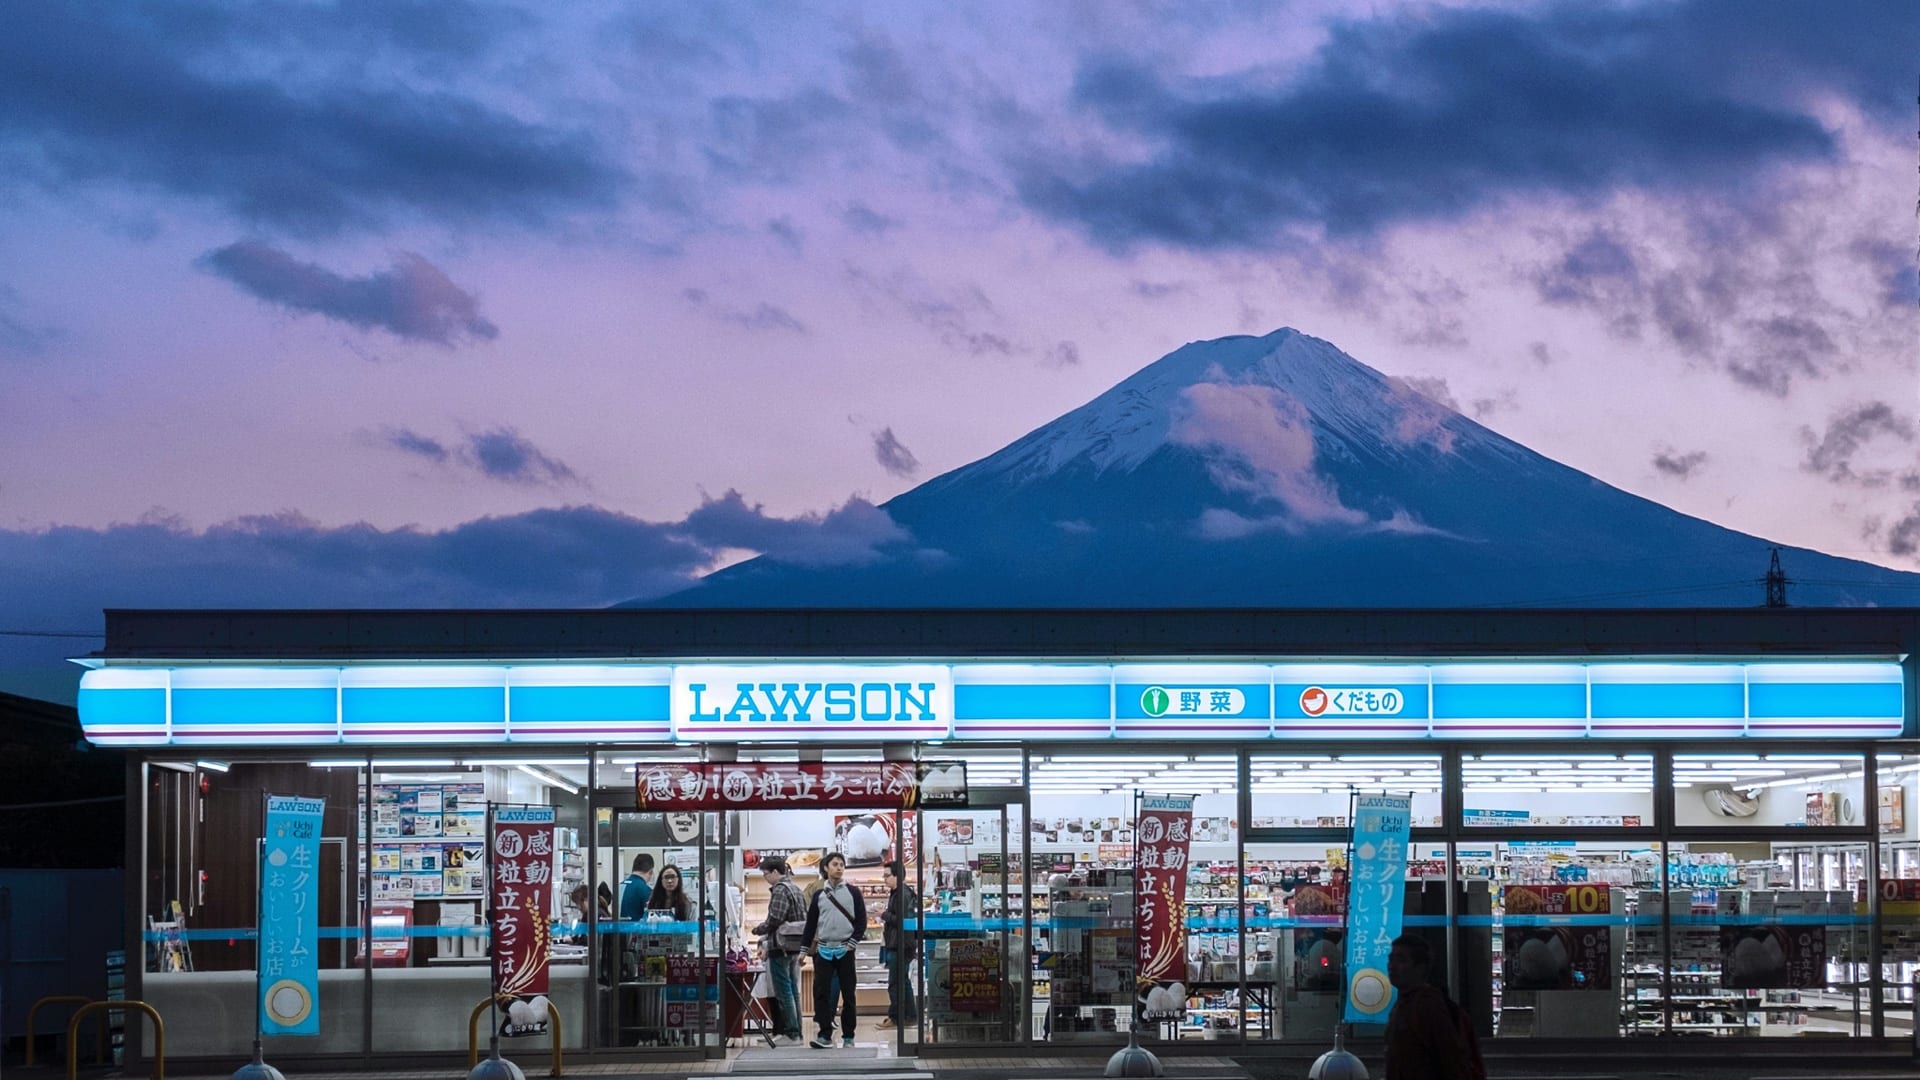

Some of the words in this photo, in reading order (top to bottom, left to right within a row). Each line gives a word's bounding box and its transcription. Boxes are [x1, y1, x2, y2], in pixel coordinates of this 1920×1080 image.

[689, 683, 936, 722] LAWSON
[1179, 691, 1232, 712] 野菜
[1332, 691, 1398, 712] くだもの
[270, 801, 323, 813] LAWSON
[1143, 799, 1191, 810] LAWSON
[1358, 799, 1409, 809] LAWSON
[497, 810, 552, 821] LAWSON
[1381, 815, 1402, 825] Uchi
[293, 820, 313, 830] Uchi
[1380, 825, 1402, 834] Café
[1566, 886, 1598, 913] 10
